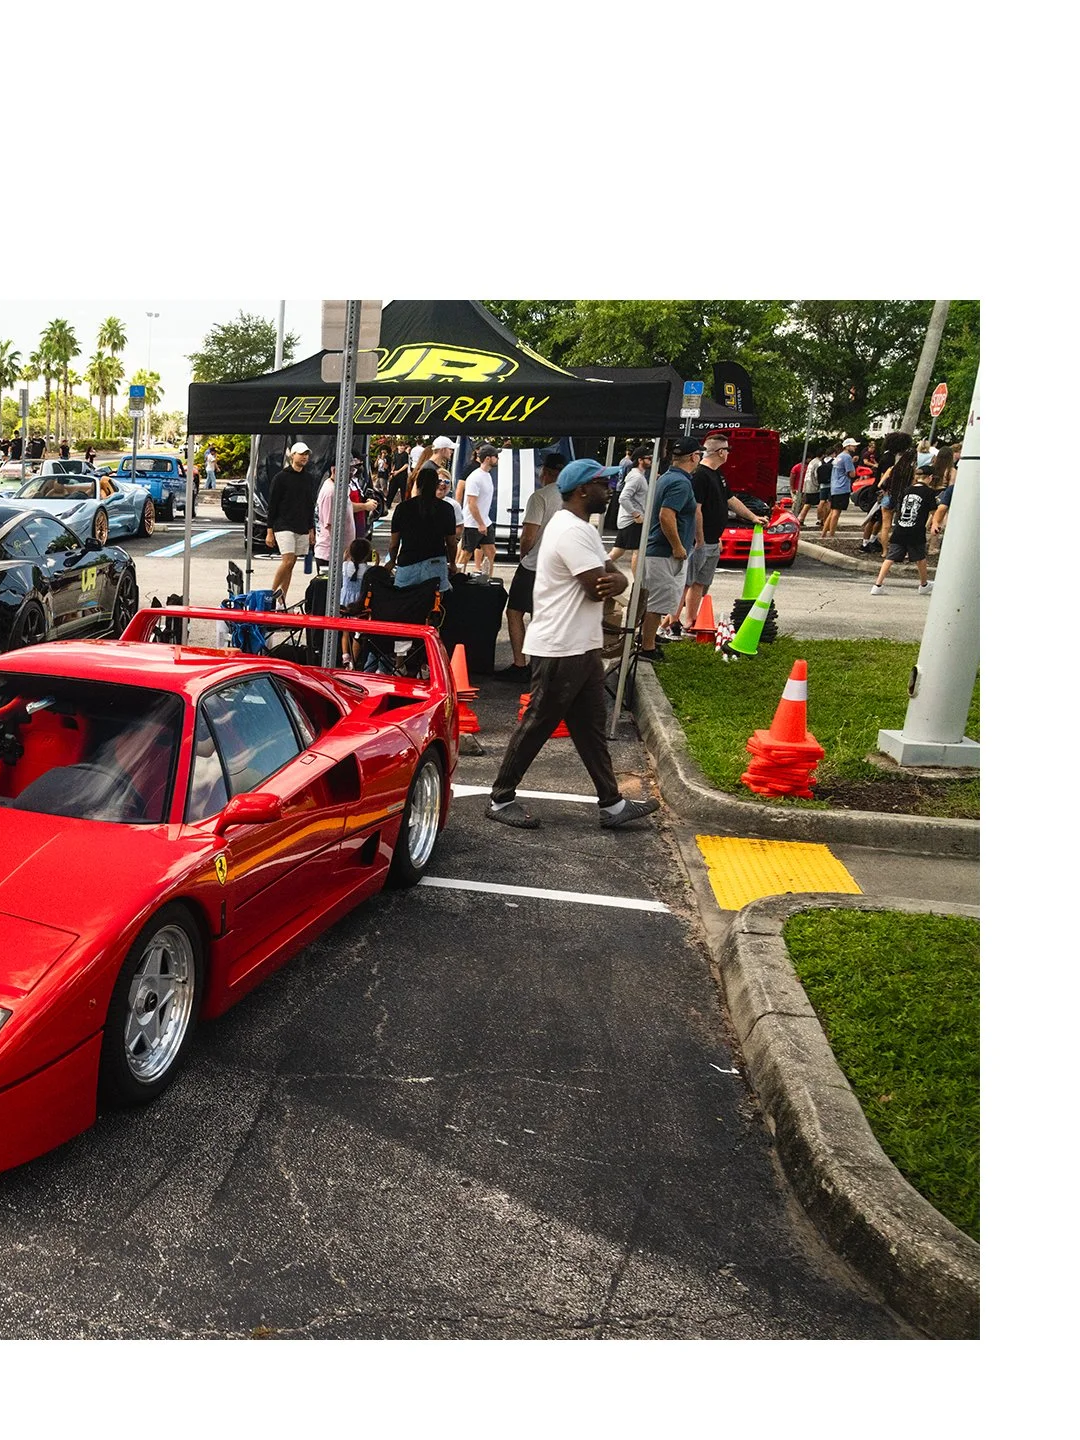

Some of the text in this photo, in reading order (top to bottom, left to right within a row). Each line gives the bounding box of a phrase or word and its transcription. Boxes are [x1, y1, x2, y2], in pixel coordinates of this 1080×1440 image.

[931, 394, 946, 405] STOP
[444, 394, 550, 423] RALLY
[679, 422, 741, 430] 31-676-3100
